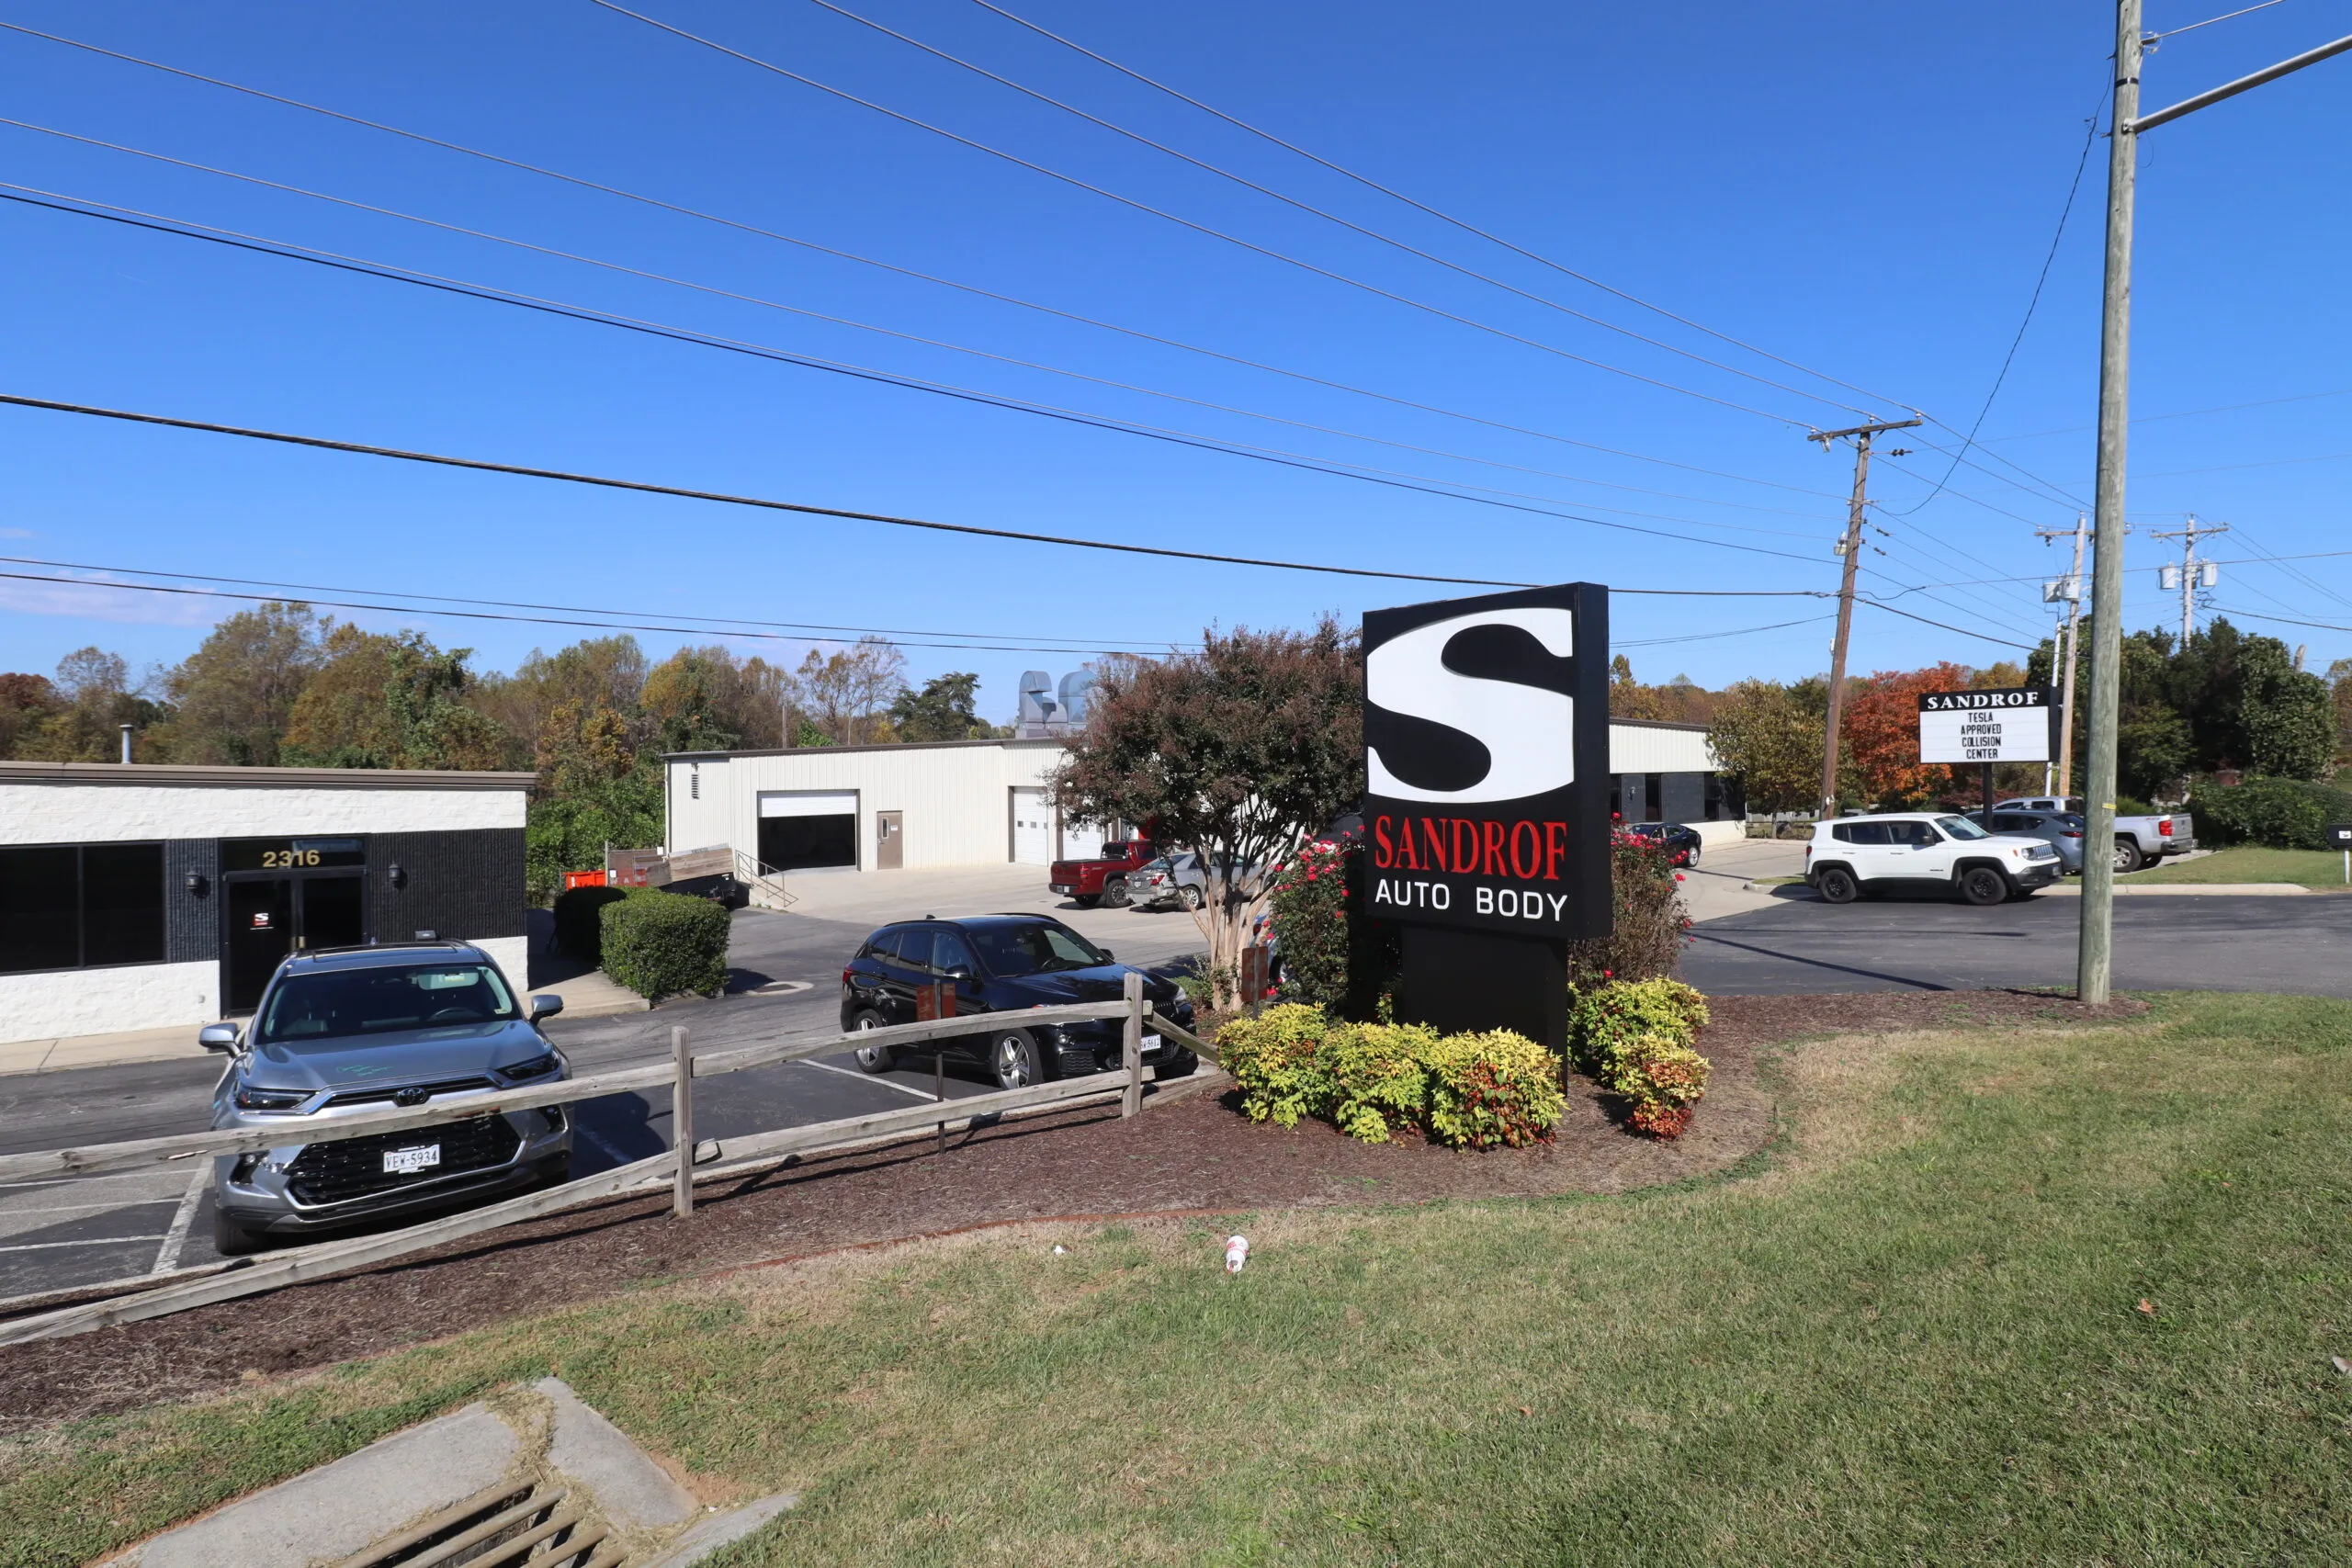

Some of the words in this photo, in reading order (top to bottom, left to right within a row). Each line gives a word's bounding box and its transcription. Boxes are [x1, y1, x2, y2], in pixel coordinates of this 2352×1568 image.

[1367, 608, 1574, 804] S
[1927, 692, 2039, 709] SANDROF
[1968, 711, 1994, 723] TESLA
[1961, 723, 2002, 736] APPROVED
[1962, 736, 2001, 748] COLLISION
[1966, 748, 1998, 760] CENTER
[1374, 815, 1568, 881] SANDROF
[263, 849, 321, 868] 2316
[1374, 878, 1451, 910] AUTO
[1476, 886, 1568, 922] BODY
